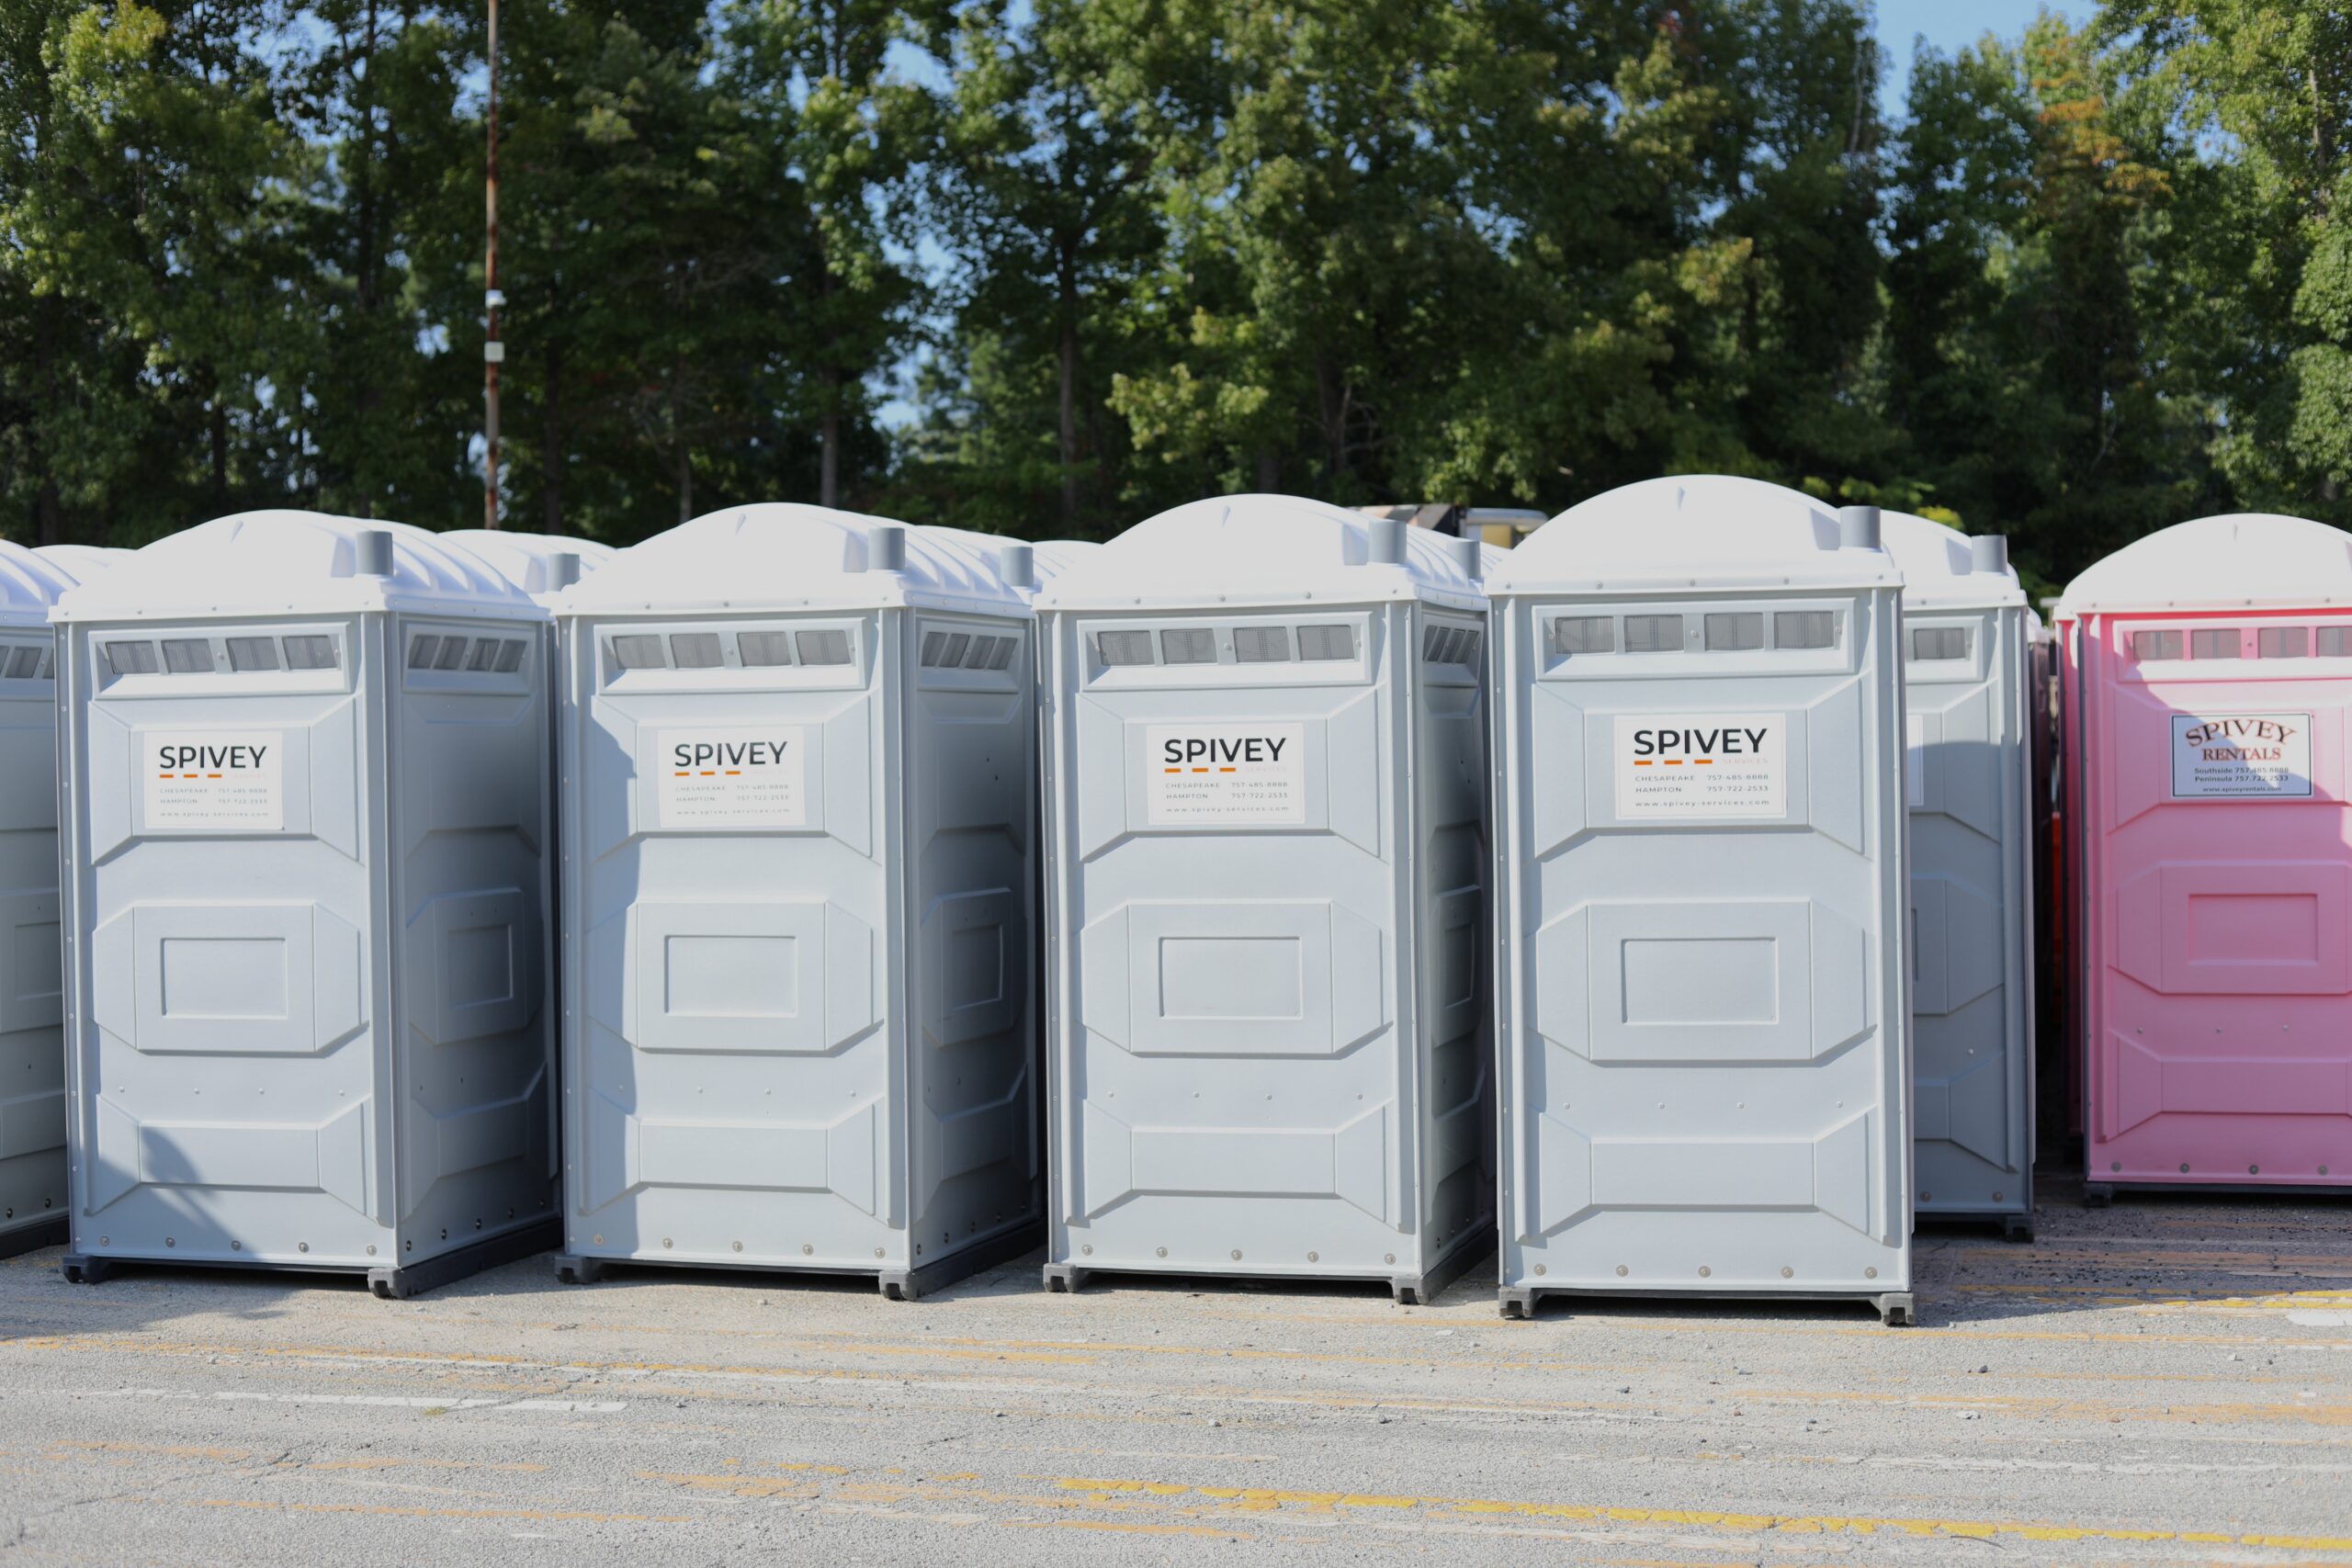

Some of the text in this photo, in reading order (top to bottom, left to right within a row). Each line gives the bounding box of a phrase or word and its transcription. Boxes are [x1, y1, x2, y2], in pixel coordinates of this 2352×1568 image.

[1634, 728, 1768, 755] SPIVEY
[2185, 718, 2297, 747] SPIVEY
[160, 746, 266, 769] SPIVEY
[674, 741, 787, 767] SPIVEY
[1164, 738, 1287, 763] SPIVEY
[2202, 747, 2281, 761] RENTALS
